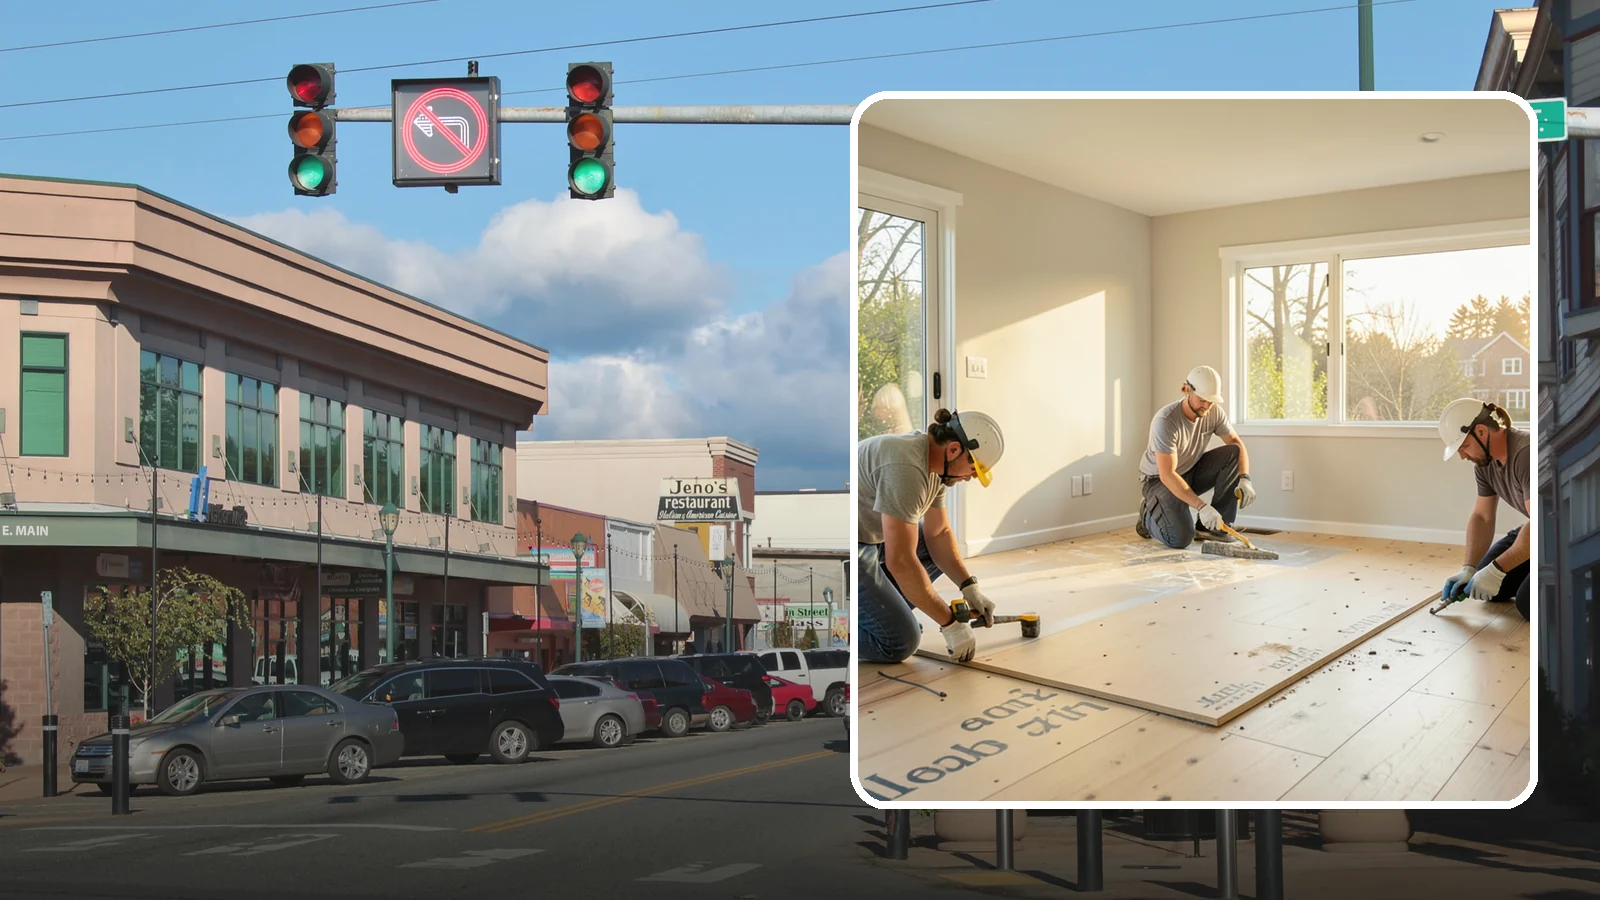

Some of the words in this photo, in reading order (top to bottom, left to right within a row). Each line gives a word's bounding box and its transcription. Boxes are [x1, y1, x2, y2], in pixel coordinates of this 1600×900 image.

[670, 480, 727, 494] Jeno's
[665, 496, 731, 509] restaurant
[659, 510, 681, 520] Italian
[686, 509, 714, 519] American
[715, 509, 738, 519] Cuisine
[2, 525, 13, 536] E.
[15, 525, 49, 536] MAIN
[797, 607, 829, 617] Street
